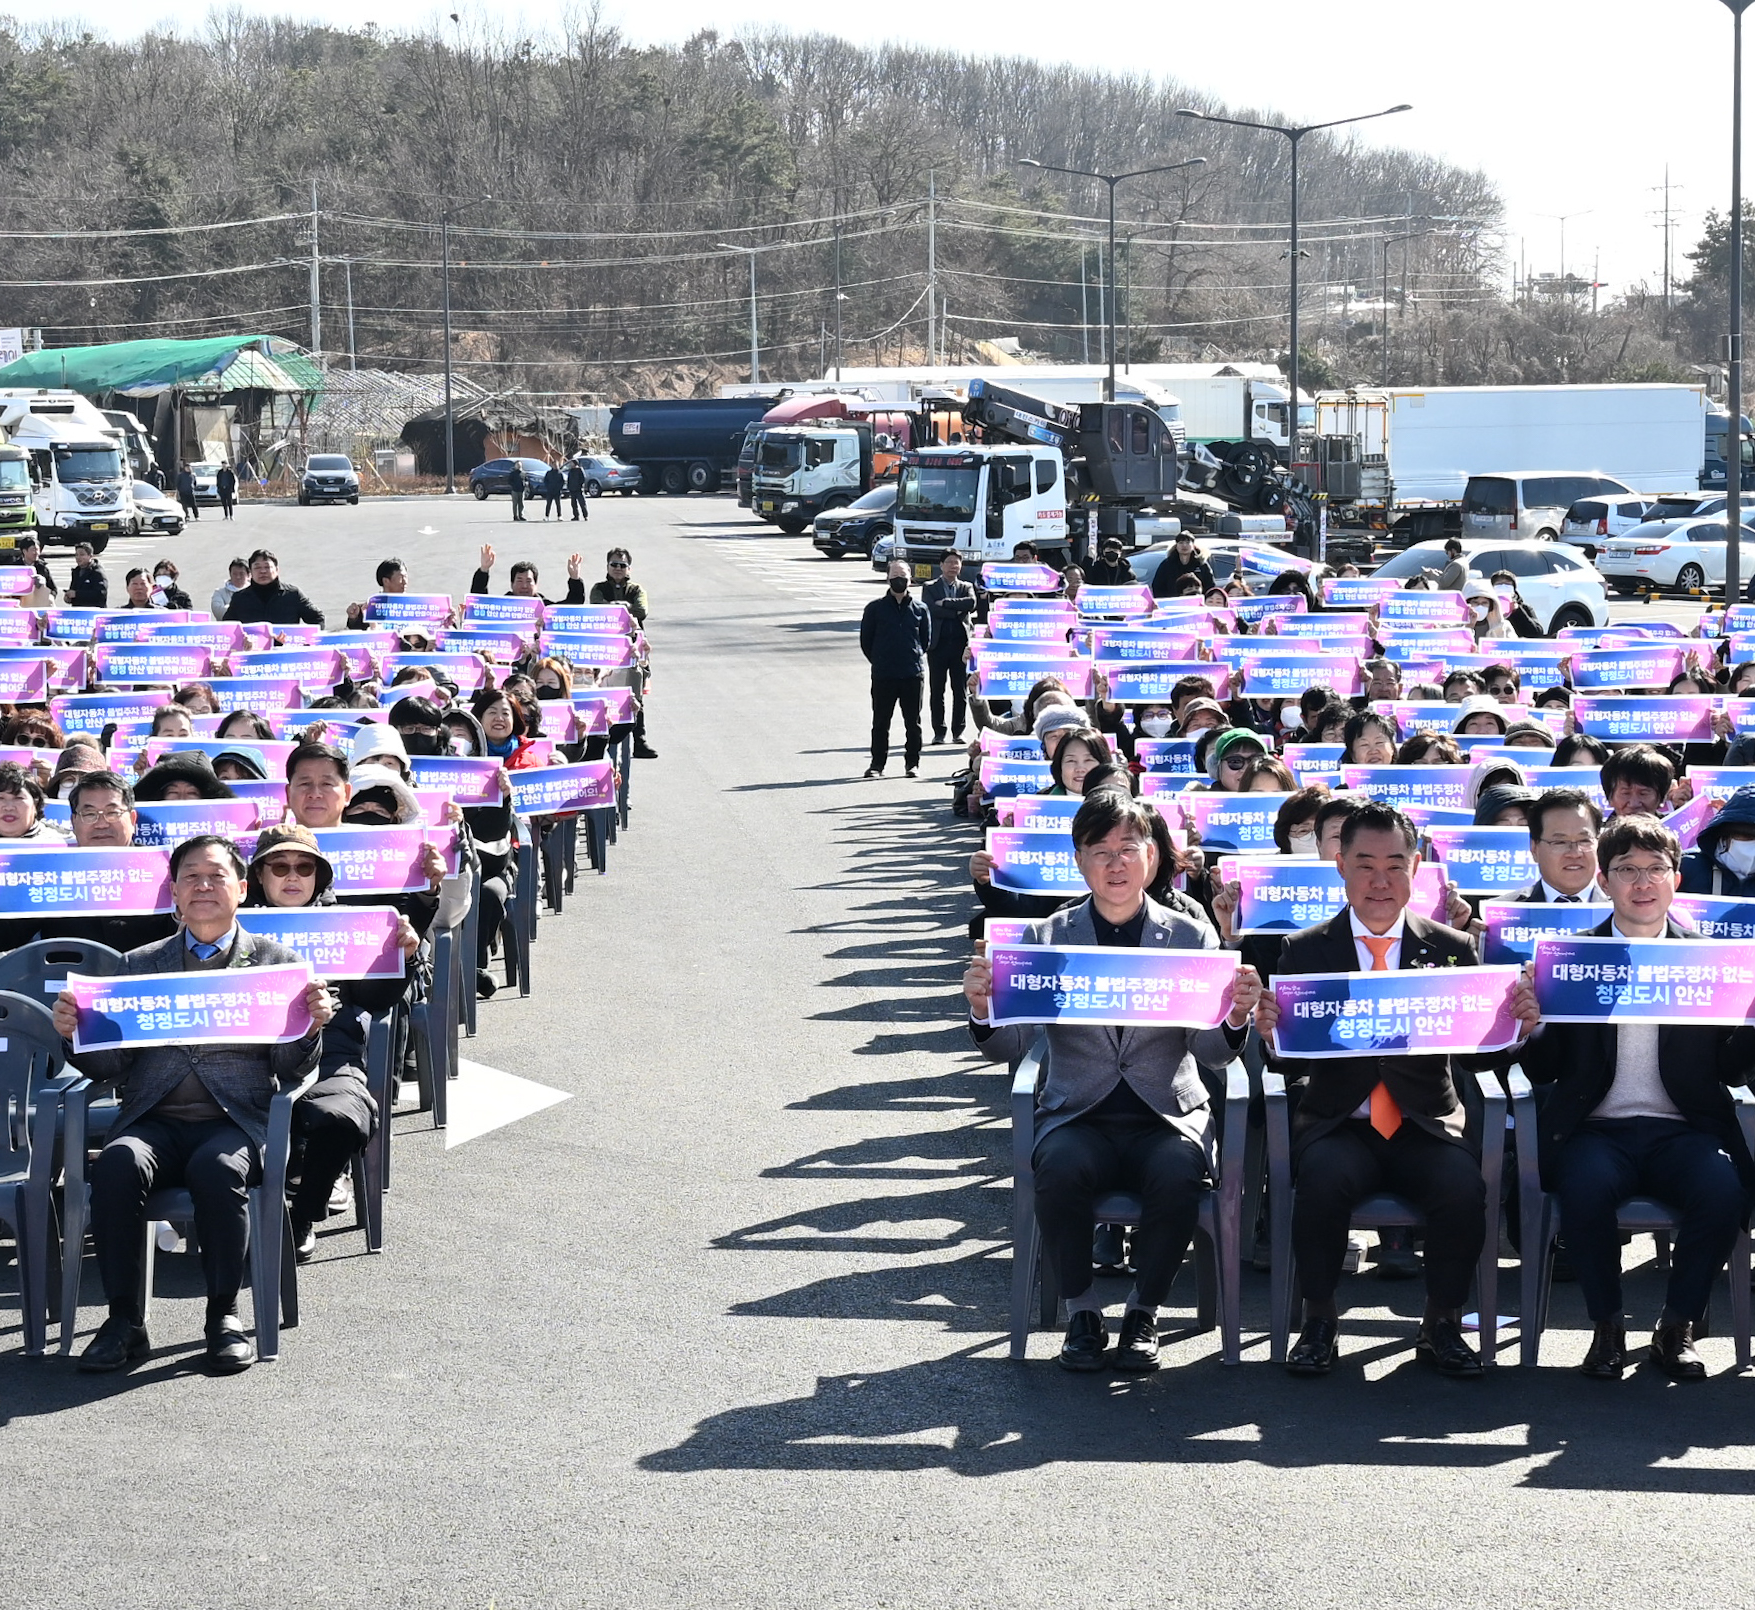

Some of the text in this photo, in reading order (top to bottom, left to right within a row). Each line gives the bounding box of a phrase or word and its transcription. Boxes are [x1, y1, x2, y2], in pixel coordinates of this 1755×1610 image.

[429, 604, 439, 612] 없는
[8, 673, 27, 682] 없는
[1250, 667, 1355, 678] 대형자동차 불법주정차 없는
[1272, 678, 1331, 689] 청정도시 안산
[1584, 710, 1700, 722] 대형자동차 불법주정차 없는
[1609, 722, 1675, 734] 청정도시 안산
[545, 776, 597, 791] 불법주차 없는
[522, 788, 598, 806] 안산 함께 만들어요!
[57, 869, 124, 885] 불법주정차
[128, 869, 153, 882] 없는
[29, 885, 122, 902] 청정도시 안산
[1553, 964, 1754, 983] 대형자동차 불법주정차 없는
[1011, 974, 1210, 993] 대형자동차 불법주정차 없는
[92, 989, 287, 1012] 대형자동차 불법주정차 없는
[1054, 993, 1169, 1011] 청정도시 안산
[1596, 985, 1713, 1006] 청정도시 안산
[1294, 995, 1493, 1018] 대형자동차 불법주정차 없는
[137, 1008, 250, 1030] 청정도시 안산
[1337, 1016, 1453, 1039] 청정도시 안산
